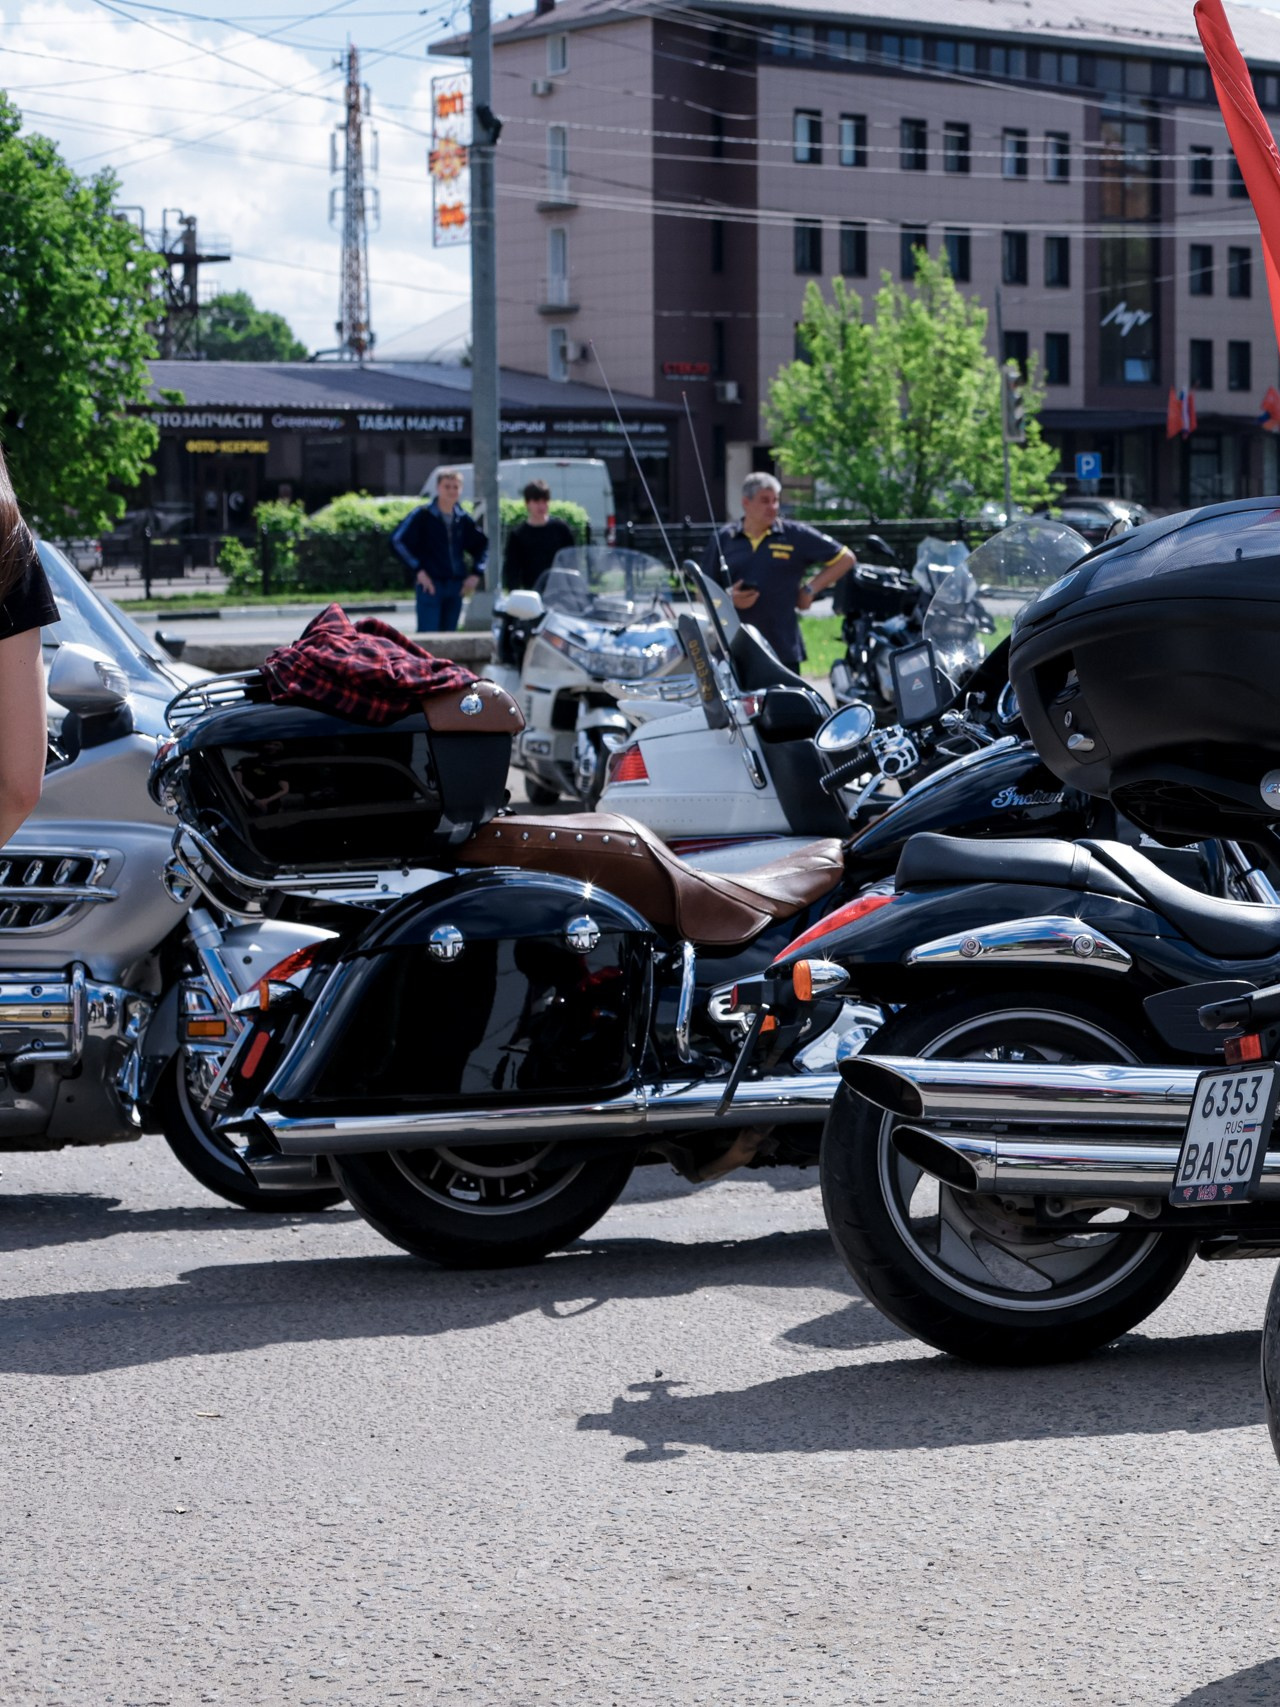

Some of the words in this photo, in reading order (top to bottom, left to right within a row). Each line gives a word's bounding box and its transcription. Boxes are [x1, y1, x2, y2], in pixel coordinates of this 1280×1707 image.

[357, 414, 404, 430] ТАБАК
[406, 415, 465, 432] МАРКЕТ
[1081, 455, 1095, 475] P
[991, 786, 1065, 808] Indian
[1201, 1075, 1263, 1119] 6353
[1224, 1120, 1244, 1136] RUS
[1221, 1138, 1253, 1178] 50
